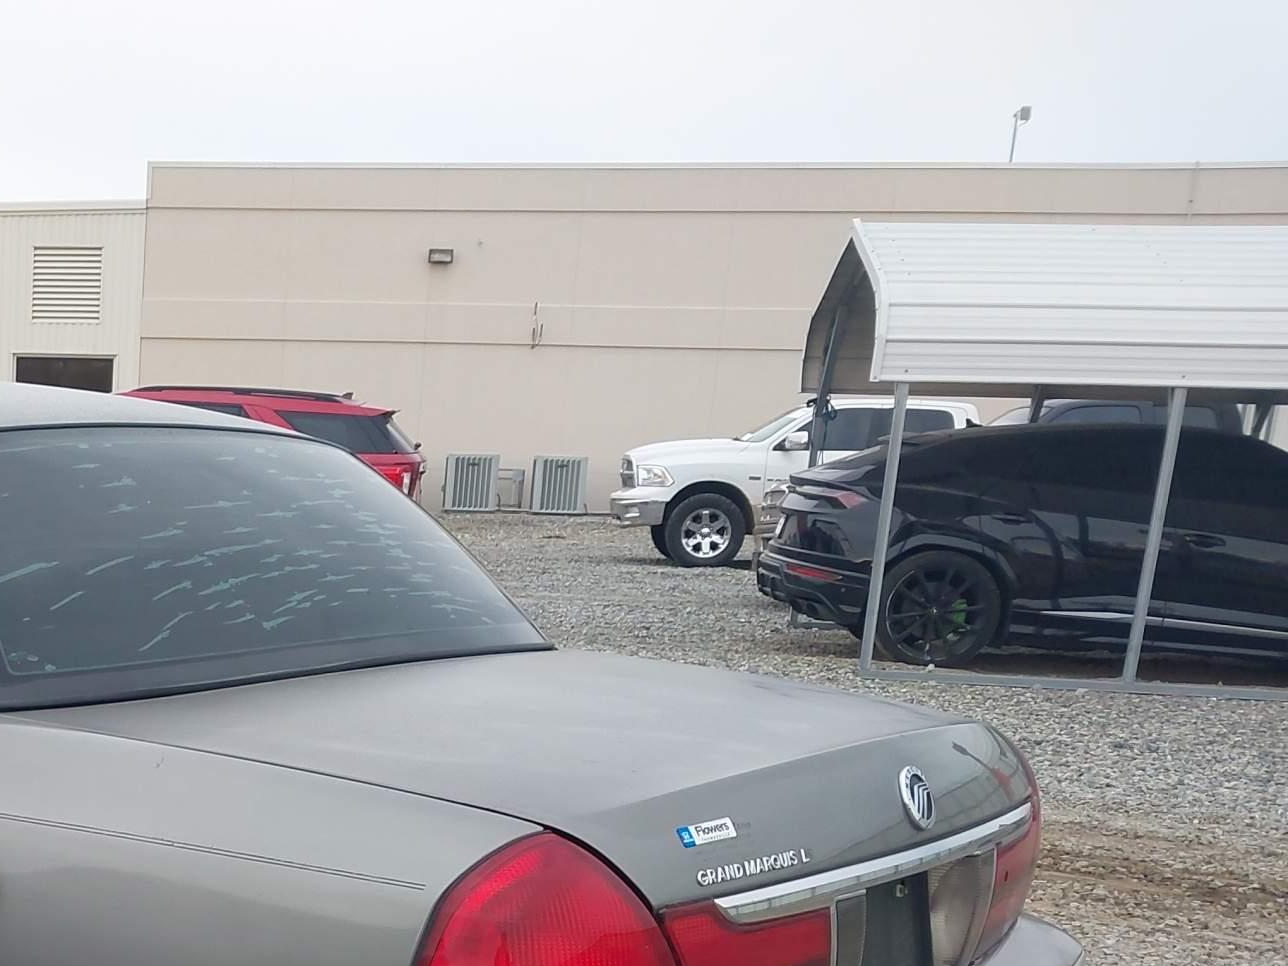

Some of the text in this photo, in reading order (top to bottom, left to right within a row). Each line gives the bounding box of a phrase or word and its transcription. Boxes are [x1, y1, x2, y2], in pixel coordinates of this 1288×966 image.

[695, 821, 730, 837] Flowers
[696, 862, 744, 887] GRAND
[744, 850, 798, 877] MARQUIS
